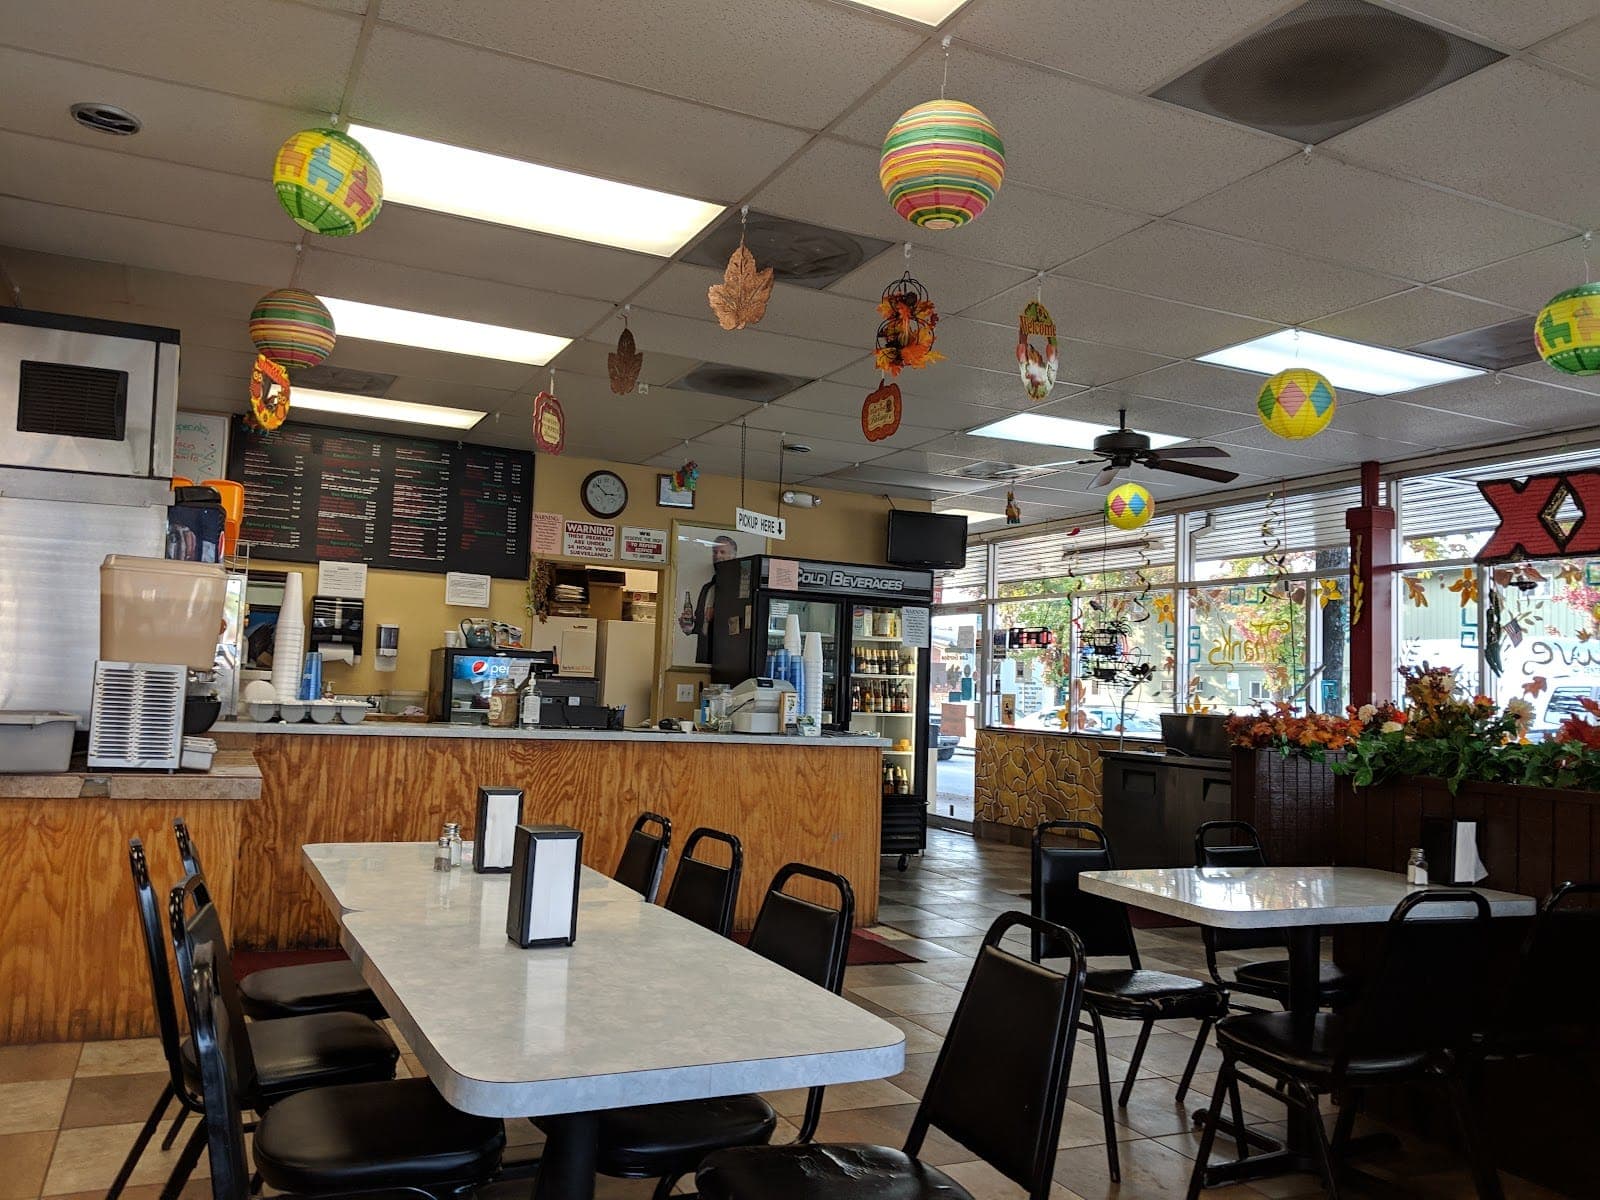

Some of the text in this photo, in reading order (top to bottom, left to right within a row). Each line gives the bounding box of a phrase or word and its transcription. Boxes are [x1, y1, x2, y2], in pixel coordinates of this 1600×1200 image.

[1020, 315, 1056, 337] Welcome
[566, 523, 614, 536] WARNING
[738, 512, 775, 534] PICKUP HERE
[569, 549, 608, 558] SURVEILLANCE
[831, 570, 904, 591] BEVERAGES
